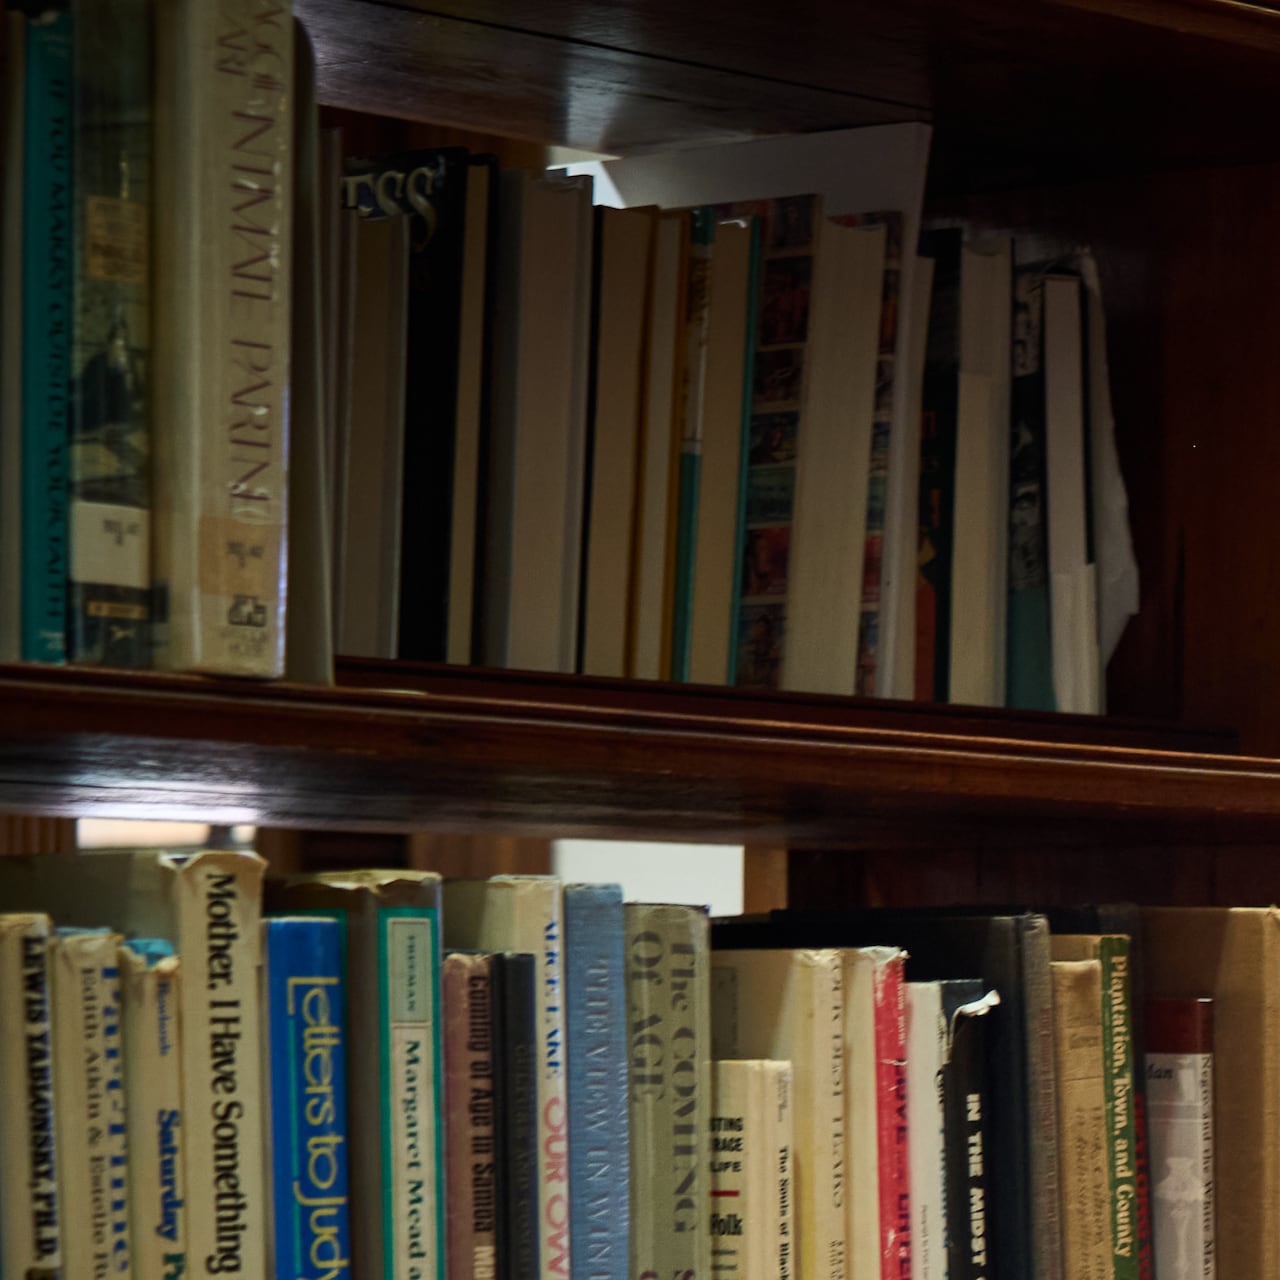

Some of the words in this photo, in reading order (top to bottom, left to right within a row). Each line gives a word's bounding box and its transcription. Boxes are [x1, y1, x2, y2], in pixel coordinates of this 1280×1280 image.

[24, 937, 49, 1023] LEWIS
[584, 958, 611, 1034] THE
[631, 930, 666, 987] Of
[671, 942, 698, 1013] The
[83, 971, 104, 1039] Edith
[211, 1001, 239, 1009] I
[467, 976, 494, 1053] Coming
[1107, 956, 1131, 1073] Plantation,
[89, 1046, 109, 1118] Atkin
[212, 1017, 242, 1094] Have
[288, 977, 341, 1126] Letters
[473, 1061, 495, 1081] of
[585, 1041, 612, 1134] VIEW
[632, 1006, 665, 1104] AGE
[28, 1033, 58, 1187] YABLONSKY,
[403, 1040, 423, 1169] Margaret
[470, 1088, 497, 1128] Age
[543, 1097, 569, 1185] OUR
[672, 1027, 698, 1234] COMING
[966, 1093, 982, 1122] IN
[1112, 1074, 1132, 1135] Town,
[157, 1109, 186, 1241] Saturday
[208, 1100, 249, 1274] Something
[304, 1134, 345, 1190] to
[779, 1147, 791, 1174] The
[967, 1131, 983, 1178] THE
[1115, 1139, 1133, 1179] and
[33, 1191, 60, 1262] PH.D.
[92, 1156, 115, 1243] Estelle
[407, 1179, 428, 1260] Mead
[474, 1163, 498, 1233] Samoa
[779, 1180, 791, 1217] Souls
[779, 1224, 791, 1237] of
[969, 1188, 988, 1267] MIDST
[1114, 1183, 1135, 1258] County
